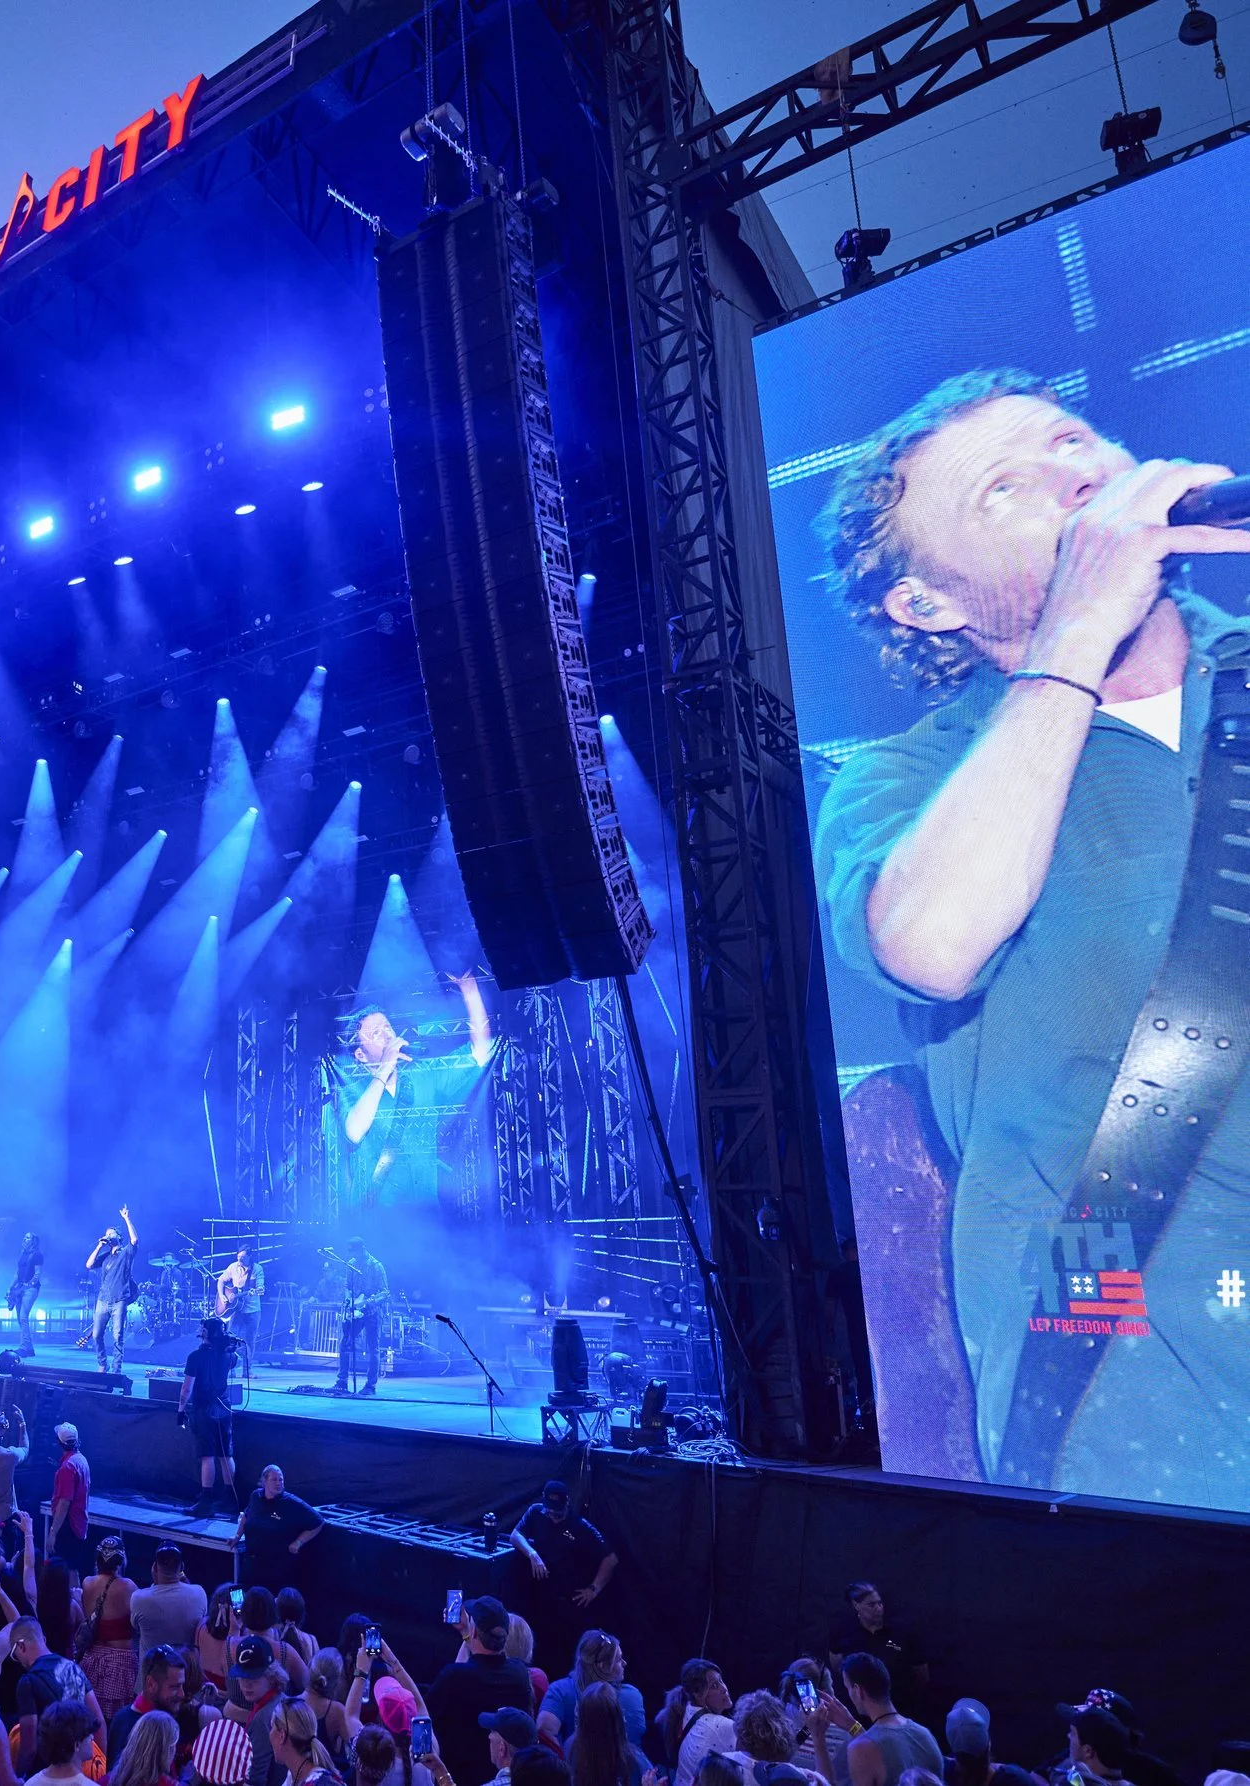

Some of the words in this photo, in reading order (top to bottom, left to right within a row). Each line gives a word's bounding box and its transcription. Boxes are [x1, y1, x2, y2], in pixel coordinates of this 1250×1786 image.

[42, 74, 208, 233] CITY
[1095, 1205, 1129, 1219] CITY
[1029, 1317, 1051, 1332] LET
[1053, 1318, 1113, 1335] FREEDOM
